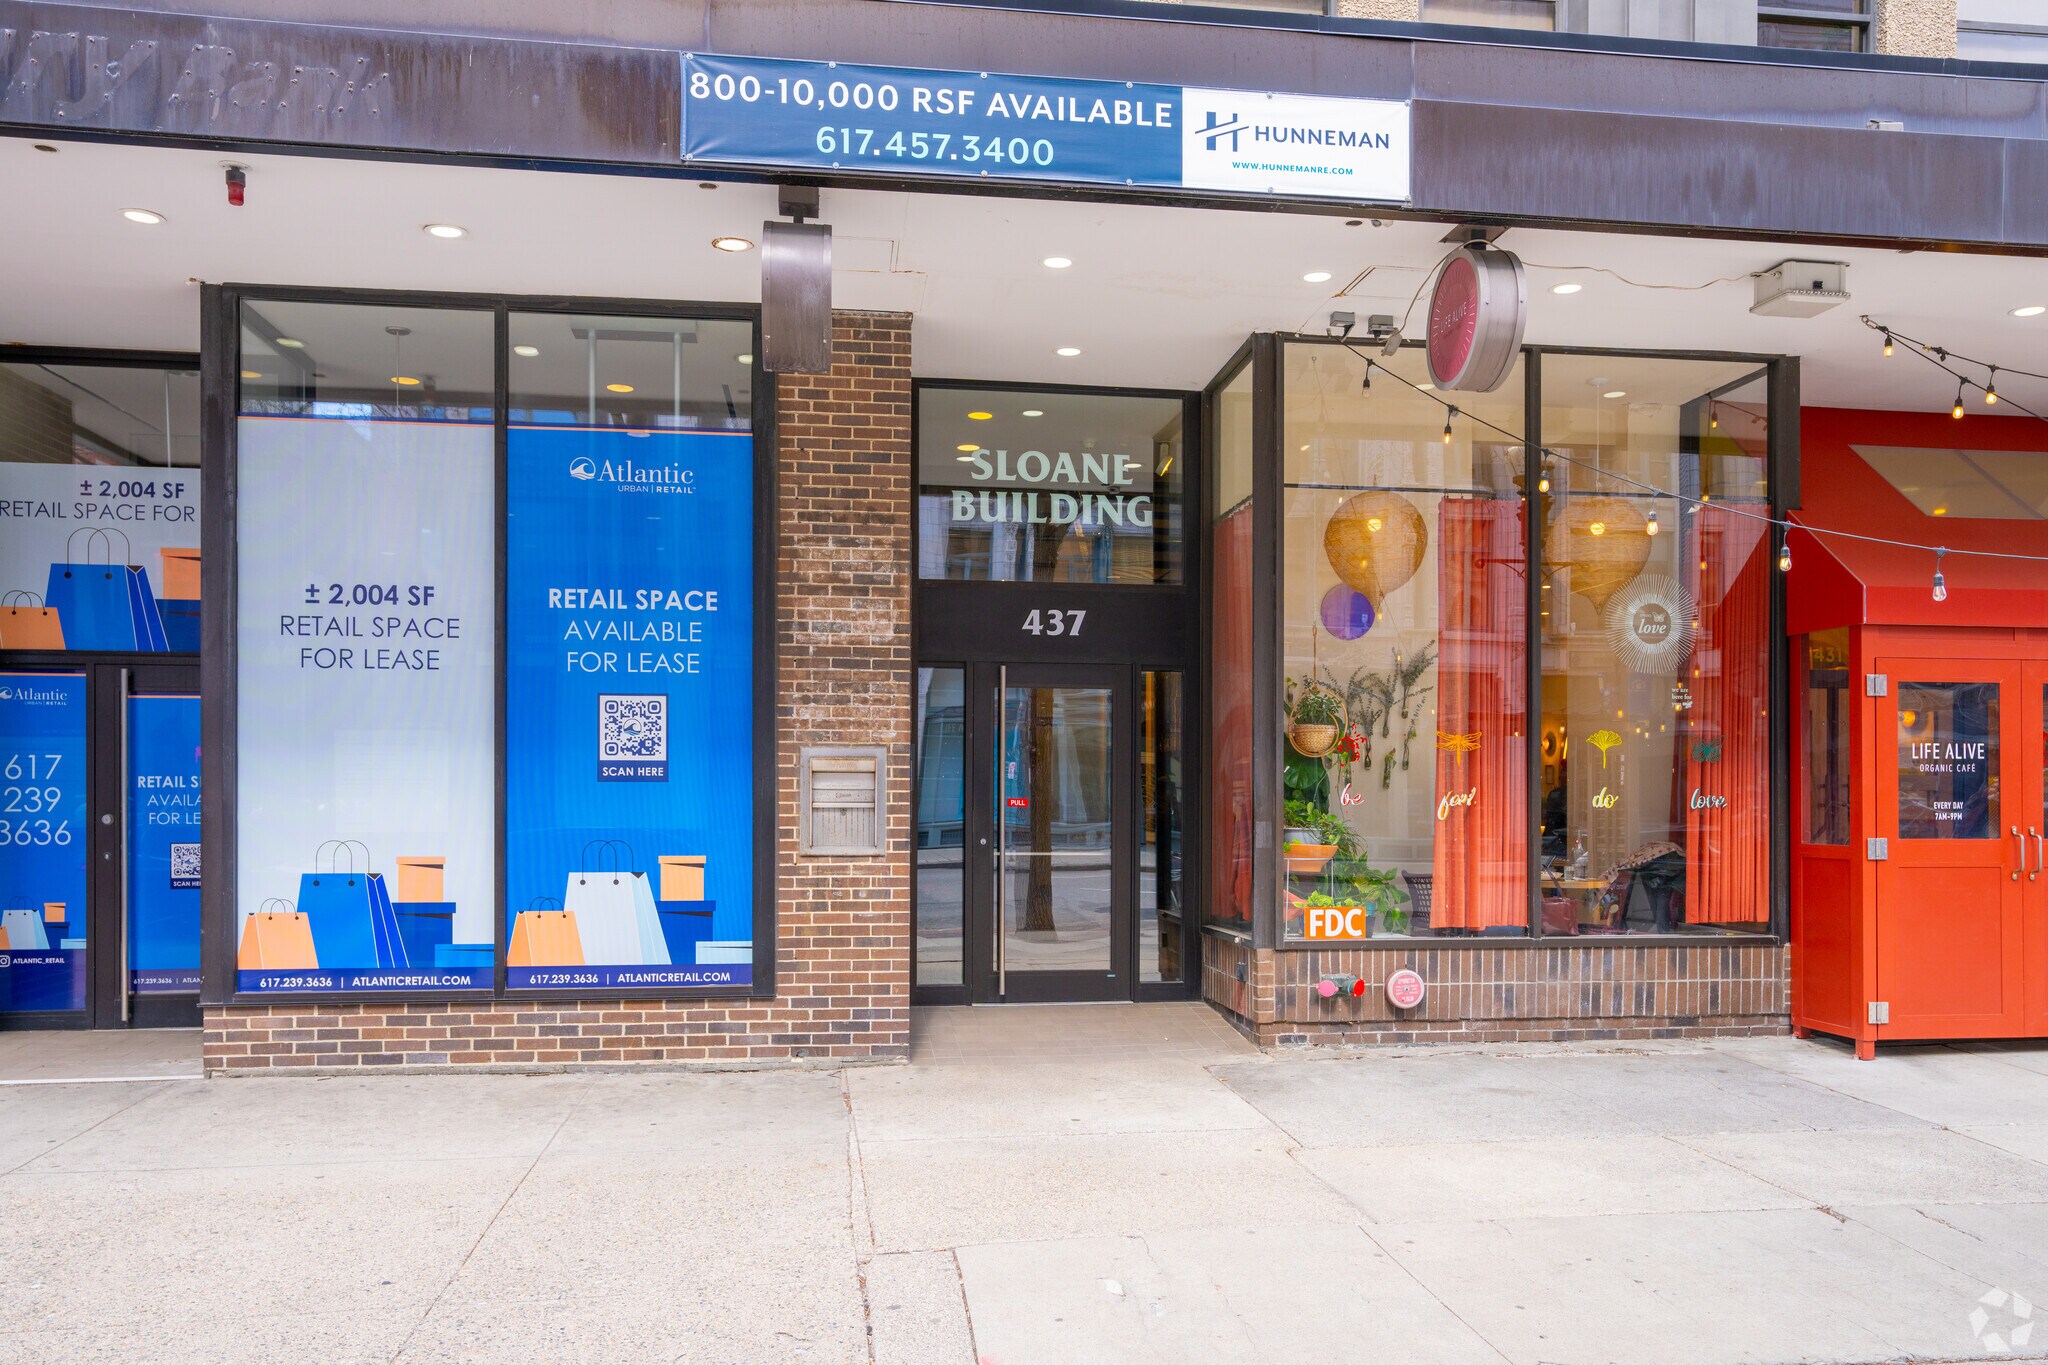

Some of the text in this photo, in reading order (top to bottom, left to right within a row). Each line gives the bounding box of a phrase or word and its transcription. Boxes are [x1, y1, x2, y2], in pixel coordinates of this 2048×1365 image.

[689, 72, 1172, 128] 800-10,000 RSF AVAILABLE
[816, 126, 1054, 166] 617.457.3400
[1254, 125, 1390, 149] HUNNEMAN
[1232, 161, 1353, 175] WWW.HUNNEMANRE.COM
[597, 459, 694, 484] Atlantic
[970, 449, 1133, 485] SLOANE
[99, 480, 156, 499] 2,004
[162, 482, 185, 499] SF
[617, 485, 693, 494] URBAN RETAIL
[0, 500, 195, 522] RETAIL SPACE FOR
[951, 490, 1154, 527] BUILDING
[328, 583, 399, 607] 2,004
[408, 585, 435, 606] SF
[548, 588, 718, 612] RETAIL SPACE
[280, 615, 460, 639] RETAIL SPACE
[563, 620, 702, 642] AVAILABLE
[1021, 609, 1087, 636] 437
[1638, 618, 1667, 634] love
[301, 647, 440, 670] FOR LEASE
[567, 651, 700, 674] FOR LEASE
[14, 688, 68, 700] Atlantic
[1912, 743, 1985, 759] LIFE ALIVE
[5, 754, 63, 780] 617
[603, 766, 664, 777] SCAN HERE
[1919, 763, 1976, 772] ORGANIC CAFÉ
[138, 776, 186, 788] RETAIL
[3, 787, 61, 812] 239
[1340, 783, 1365, 806] be
[1592, 787, 1619, 809] do
[1933, 802, 1964, 810] EVERY DAY
[1934, 813, 1963, 821] 7AM-9PM
[149, 812, 180, 824] FOR
[0, 820, 72, 846] 3636
[1309, 908, 1363, 937] FDC
[12, 957, 65, 965] ATLANTIC_RETAIL
[259, 975, 471, 988] 617.239.3636 ATLANTICRETAIL.COM
[529, 972, 731, 985] 617.239.3636 ATLANTICRETAIL.COM
